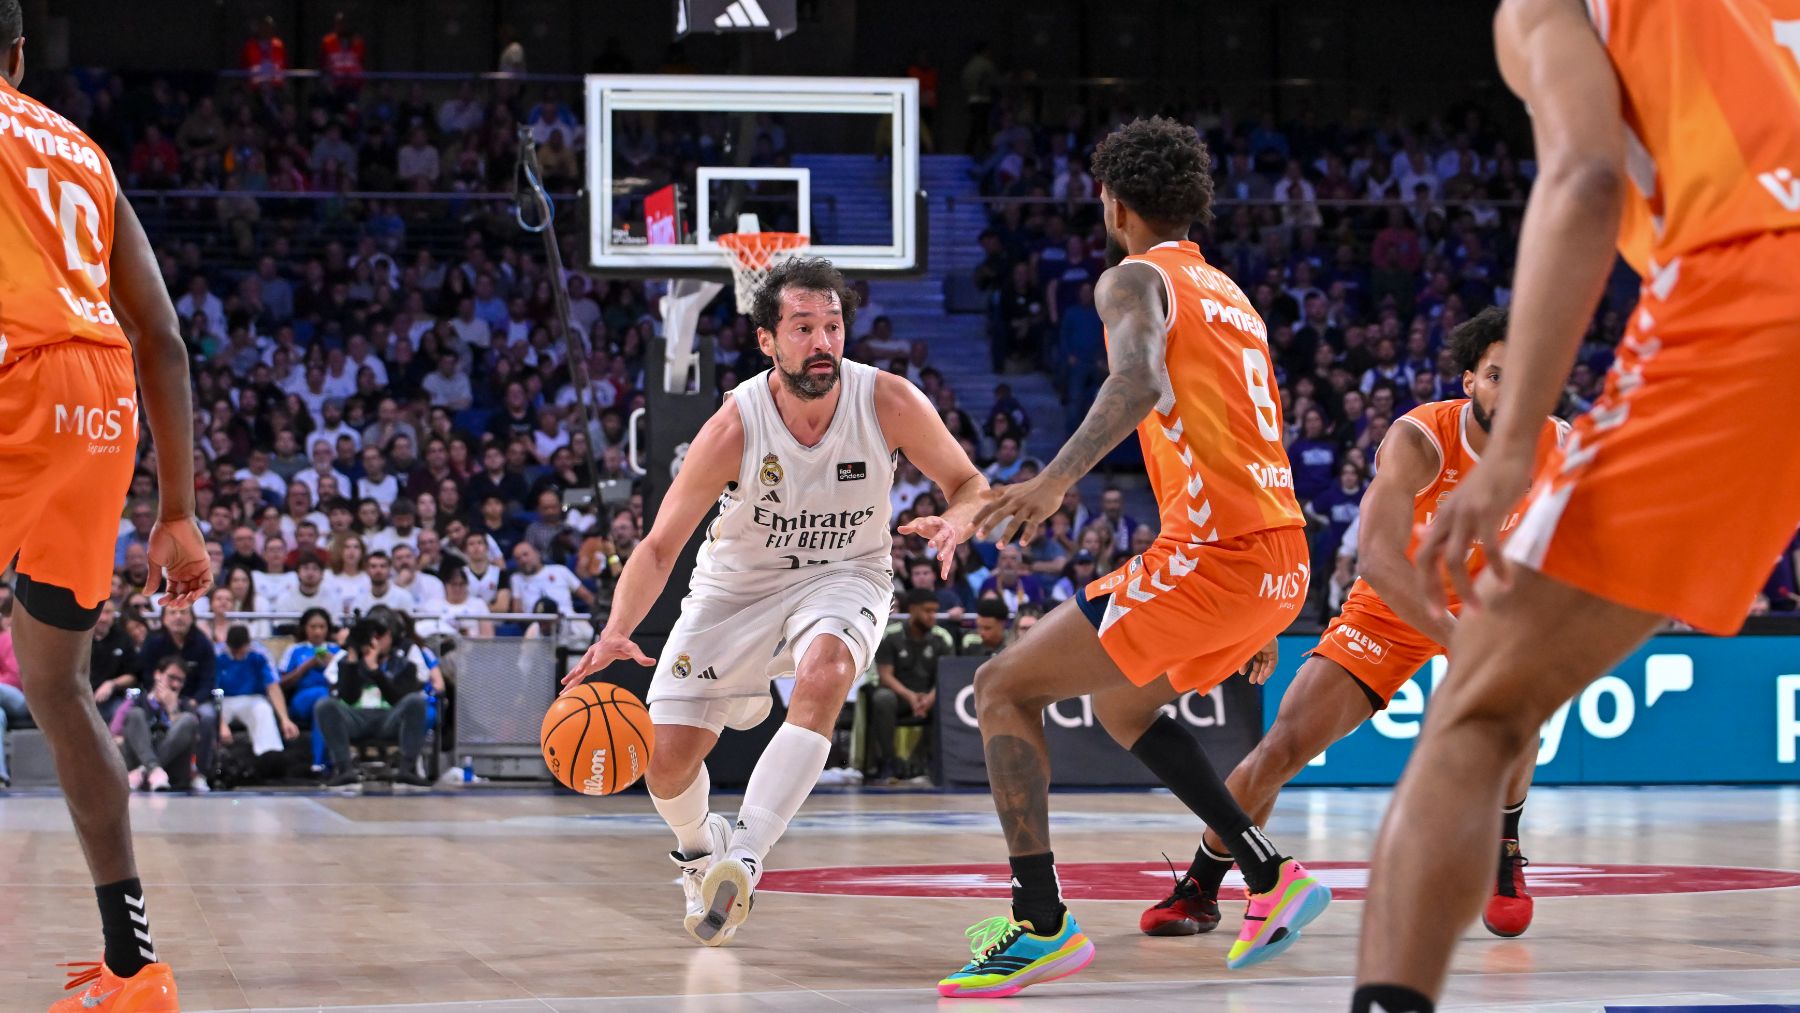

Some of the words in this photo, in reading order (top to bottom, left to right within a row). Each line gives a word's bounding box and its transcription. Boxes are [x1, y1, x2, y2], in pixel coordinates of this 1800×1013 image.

[26, 167, 107, 289] 10
[1242, 348, 1280, 441] 8
[55, 403, 122, 440] MGS
[753, 504, 875, 532] Emirates
[765, 533, 794, 548] FLY
[798, 529, 857, 549] BETTER
[1258, 572, 1300, 600] MGS
[1335, 624, 1382, 656] PULEVA
